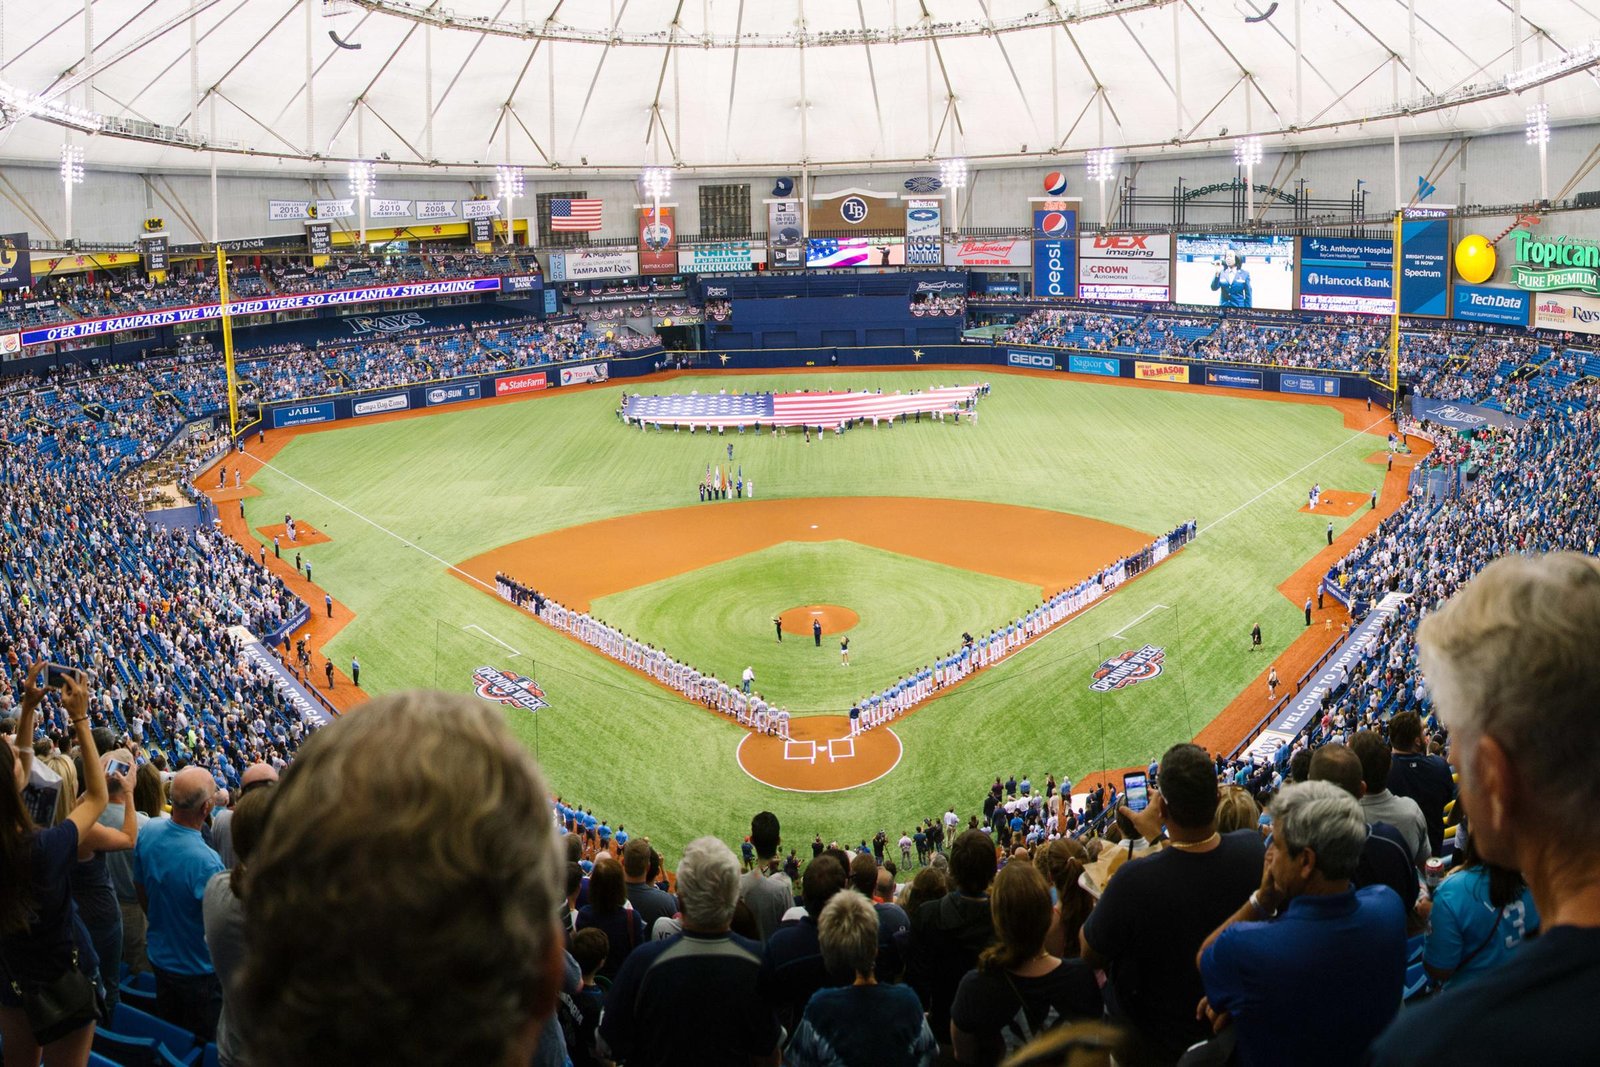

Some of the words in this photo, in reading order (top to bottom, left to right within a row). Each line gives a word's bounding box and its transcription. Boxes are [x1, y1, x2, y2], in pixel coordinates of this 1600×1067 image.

[845, 201, 864, 219] TB
[1404, 208, 1447, 218] Spectrum
[242, 240, 264, 248] Deck
[908, 235, 940, 250] ROSE
[963, 240, 1013, 252] Budweiser
[1094, 235, 1150, 249] DEX
[1105, 249, 1154, 257] imaging
[1330, 245, 1362, 254] Anthony's
[1364, 246, 1392, 255] Hospital
[1510, 230, 1600, 269] Tropican
[908, 251, 940, 263] RADIOLOGY
[573, 267, 598, 275] TAMPA
[614, 265, 632, 274] RAYS
[1046, 243, 1064, 295] pepsi
[1090, 265, 1128, 273] CROWN
[1404, 268, 1441, 278] Spectrum
[1320, 274, 1363, 285] Hancock
[1364, 276, 1389, 288] Bank
[1518, 272, 1546, 287] PURE
[1547, 272, 1597, 286] PREMIUM
[1470, 293, 1495, 306] Tech
[1495, 296, 1522, 309] Data
[48, 326, 76, 340] O'ER
[79, 323, 102, 335] THE
[105, 312, 174, 330] RAMPARTS
[179, 309, 199, 319] WE
[266, 297, 303, 310] WERE
[306, 295, 324, 305] SO
[328, 286, 400, 303] GALLANTLY
[401, 281, 476, 296] STREAMING
[1538, 304, 1550, 313] PAPA
[1573, 305, 1600, 323] RAYS
[343, 312, 427, 335] RAYS
[1009, 353, 1053, 367] GEICO
[1073, 357, 1102, 369] Sagicor
[509, 380, 528, 390] State
[527, 378, 545, 388] Farm
[447, 389, 462, 399] SUN
[288, 406, 320, 416] JABIL
[1091, 662, 1139, 691] OPENING
[1279, 683, 1326, 730] WELCOME
[1319, 670, 1336, 685] TO
[1331, 630, 1374, 674] TROPICANA
[1367, 610, 1391, 632] FIELD
[277, 675, 290, 688] TO
[476, 666, 518, 693] OPENING
